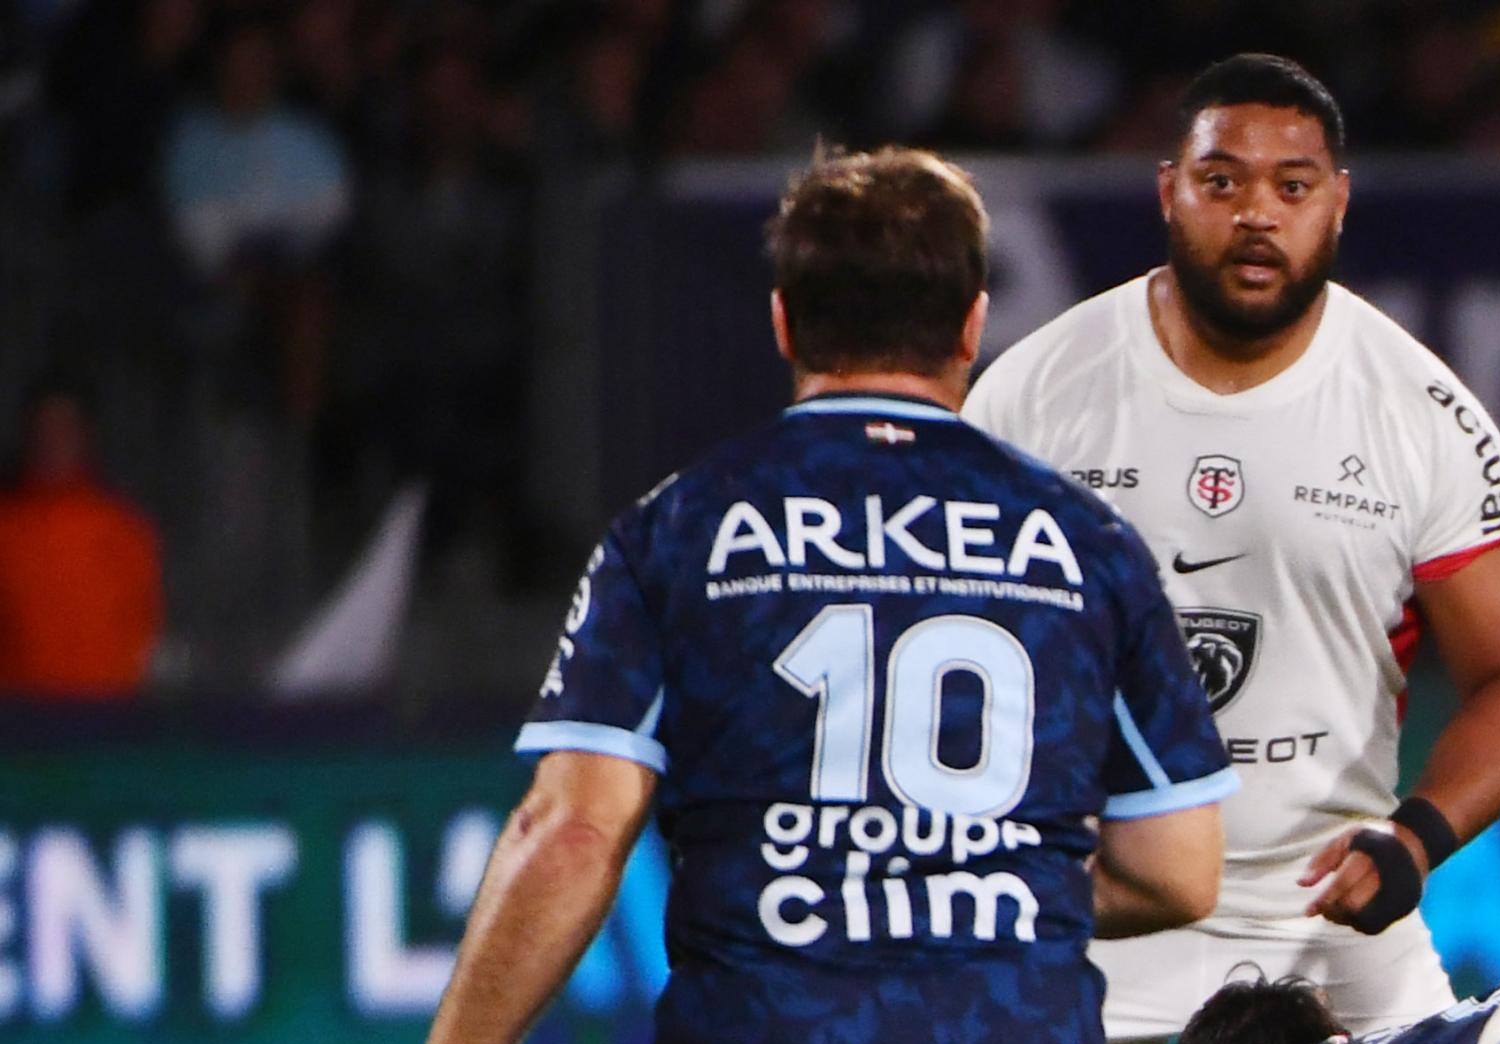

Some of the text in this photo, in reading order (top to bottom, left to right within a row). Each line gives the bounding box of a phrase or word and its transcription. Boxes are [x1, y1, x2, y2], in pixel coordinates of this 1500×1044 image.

[1293, 485, 1400, 520] REMPART
[707, 495, 1084, 576] ARKEA
[706, 573, 782, 600] BANQUE
[788, 572, 911, 594] ENTREPRISES
[914, 575, 937, 595] ET
[773, 603, 1036, 812] 10
[1227, 731, 1329, 764] EOT
[758, 850, 1040, 947] clim
